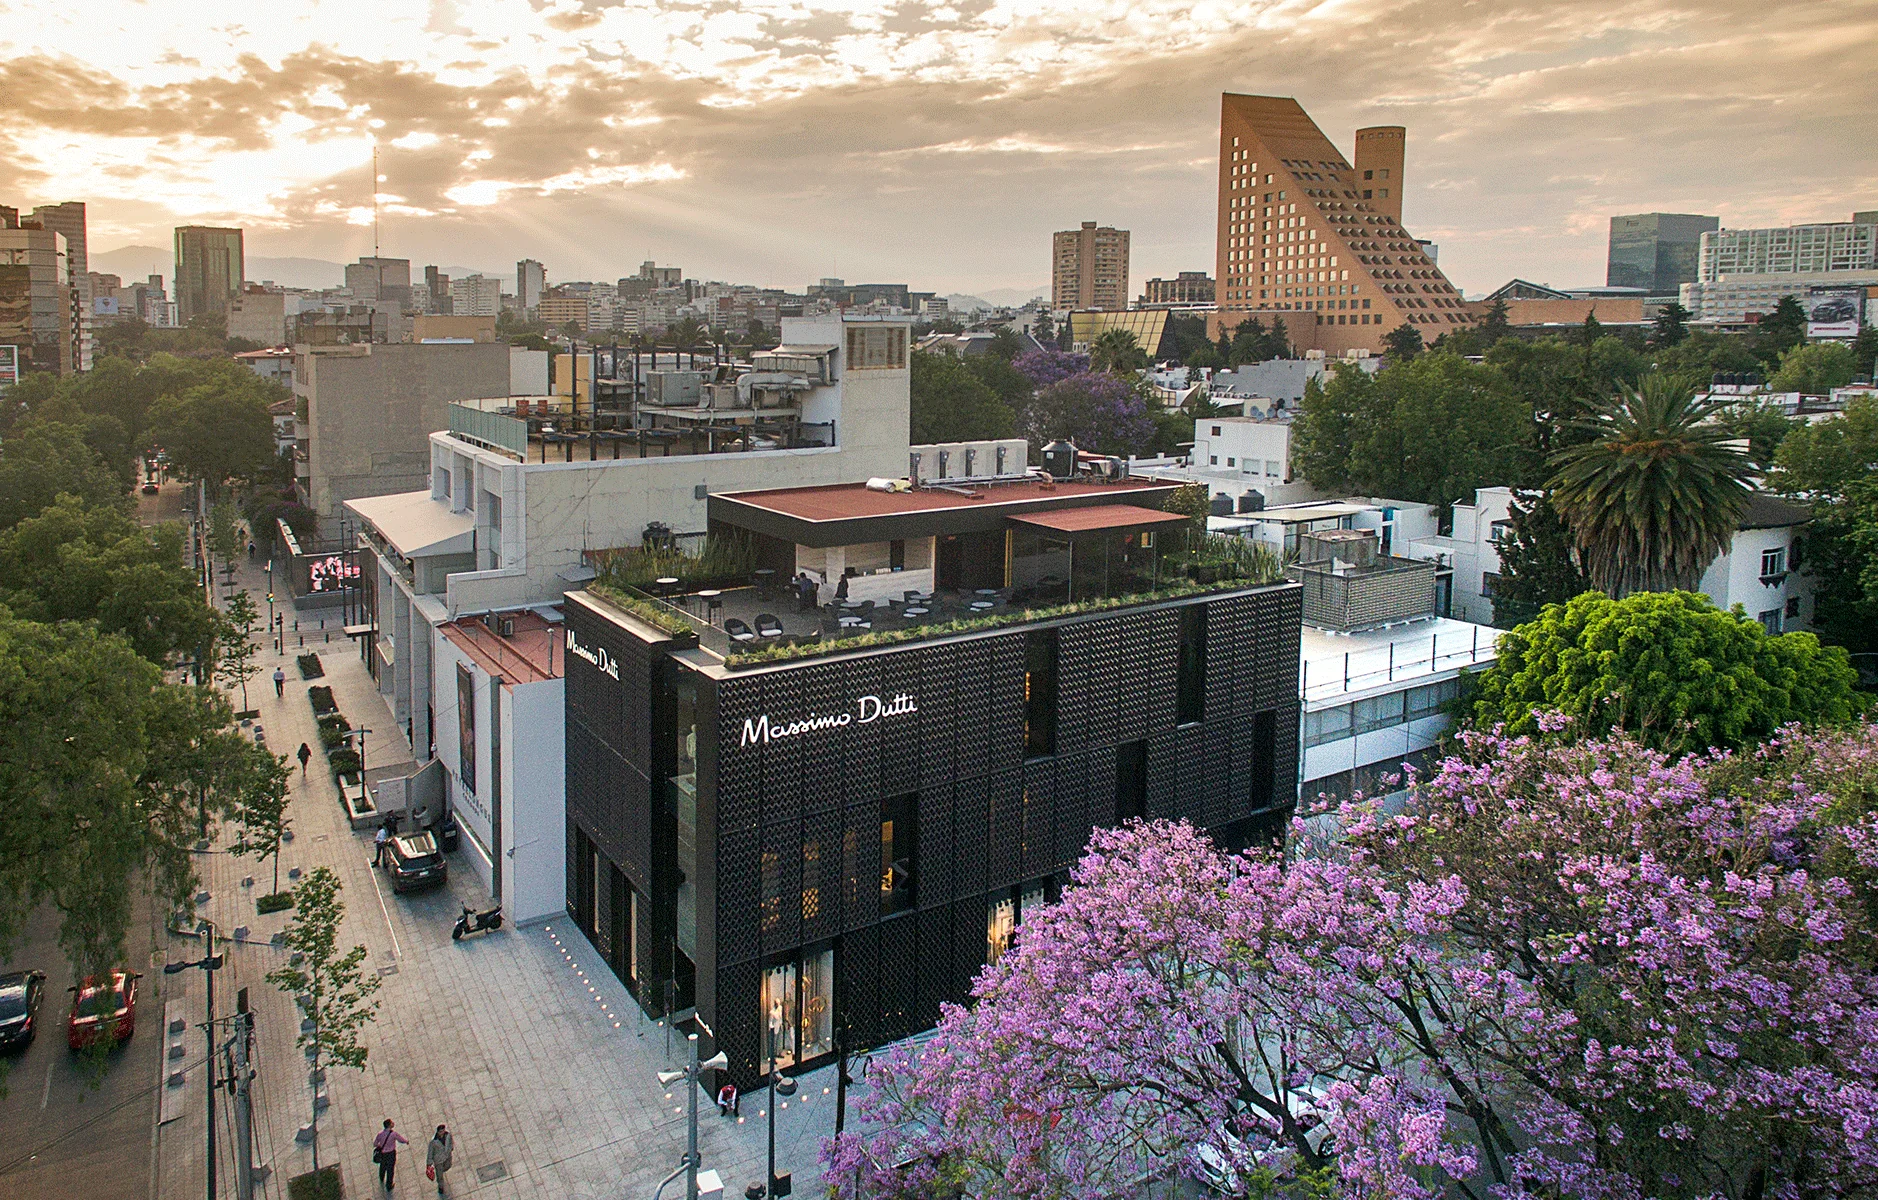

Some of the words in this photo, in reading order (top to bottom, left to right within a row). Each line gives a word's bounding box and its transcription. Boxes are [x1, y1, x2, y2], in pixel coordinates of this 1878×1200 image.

[566, 629, 598, 666] Massimo
[598, 647, 620, 681] Dutti
[740, 712, 851, 747] Massimo
[857, 692, 918, 724] Dutti
